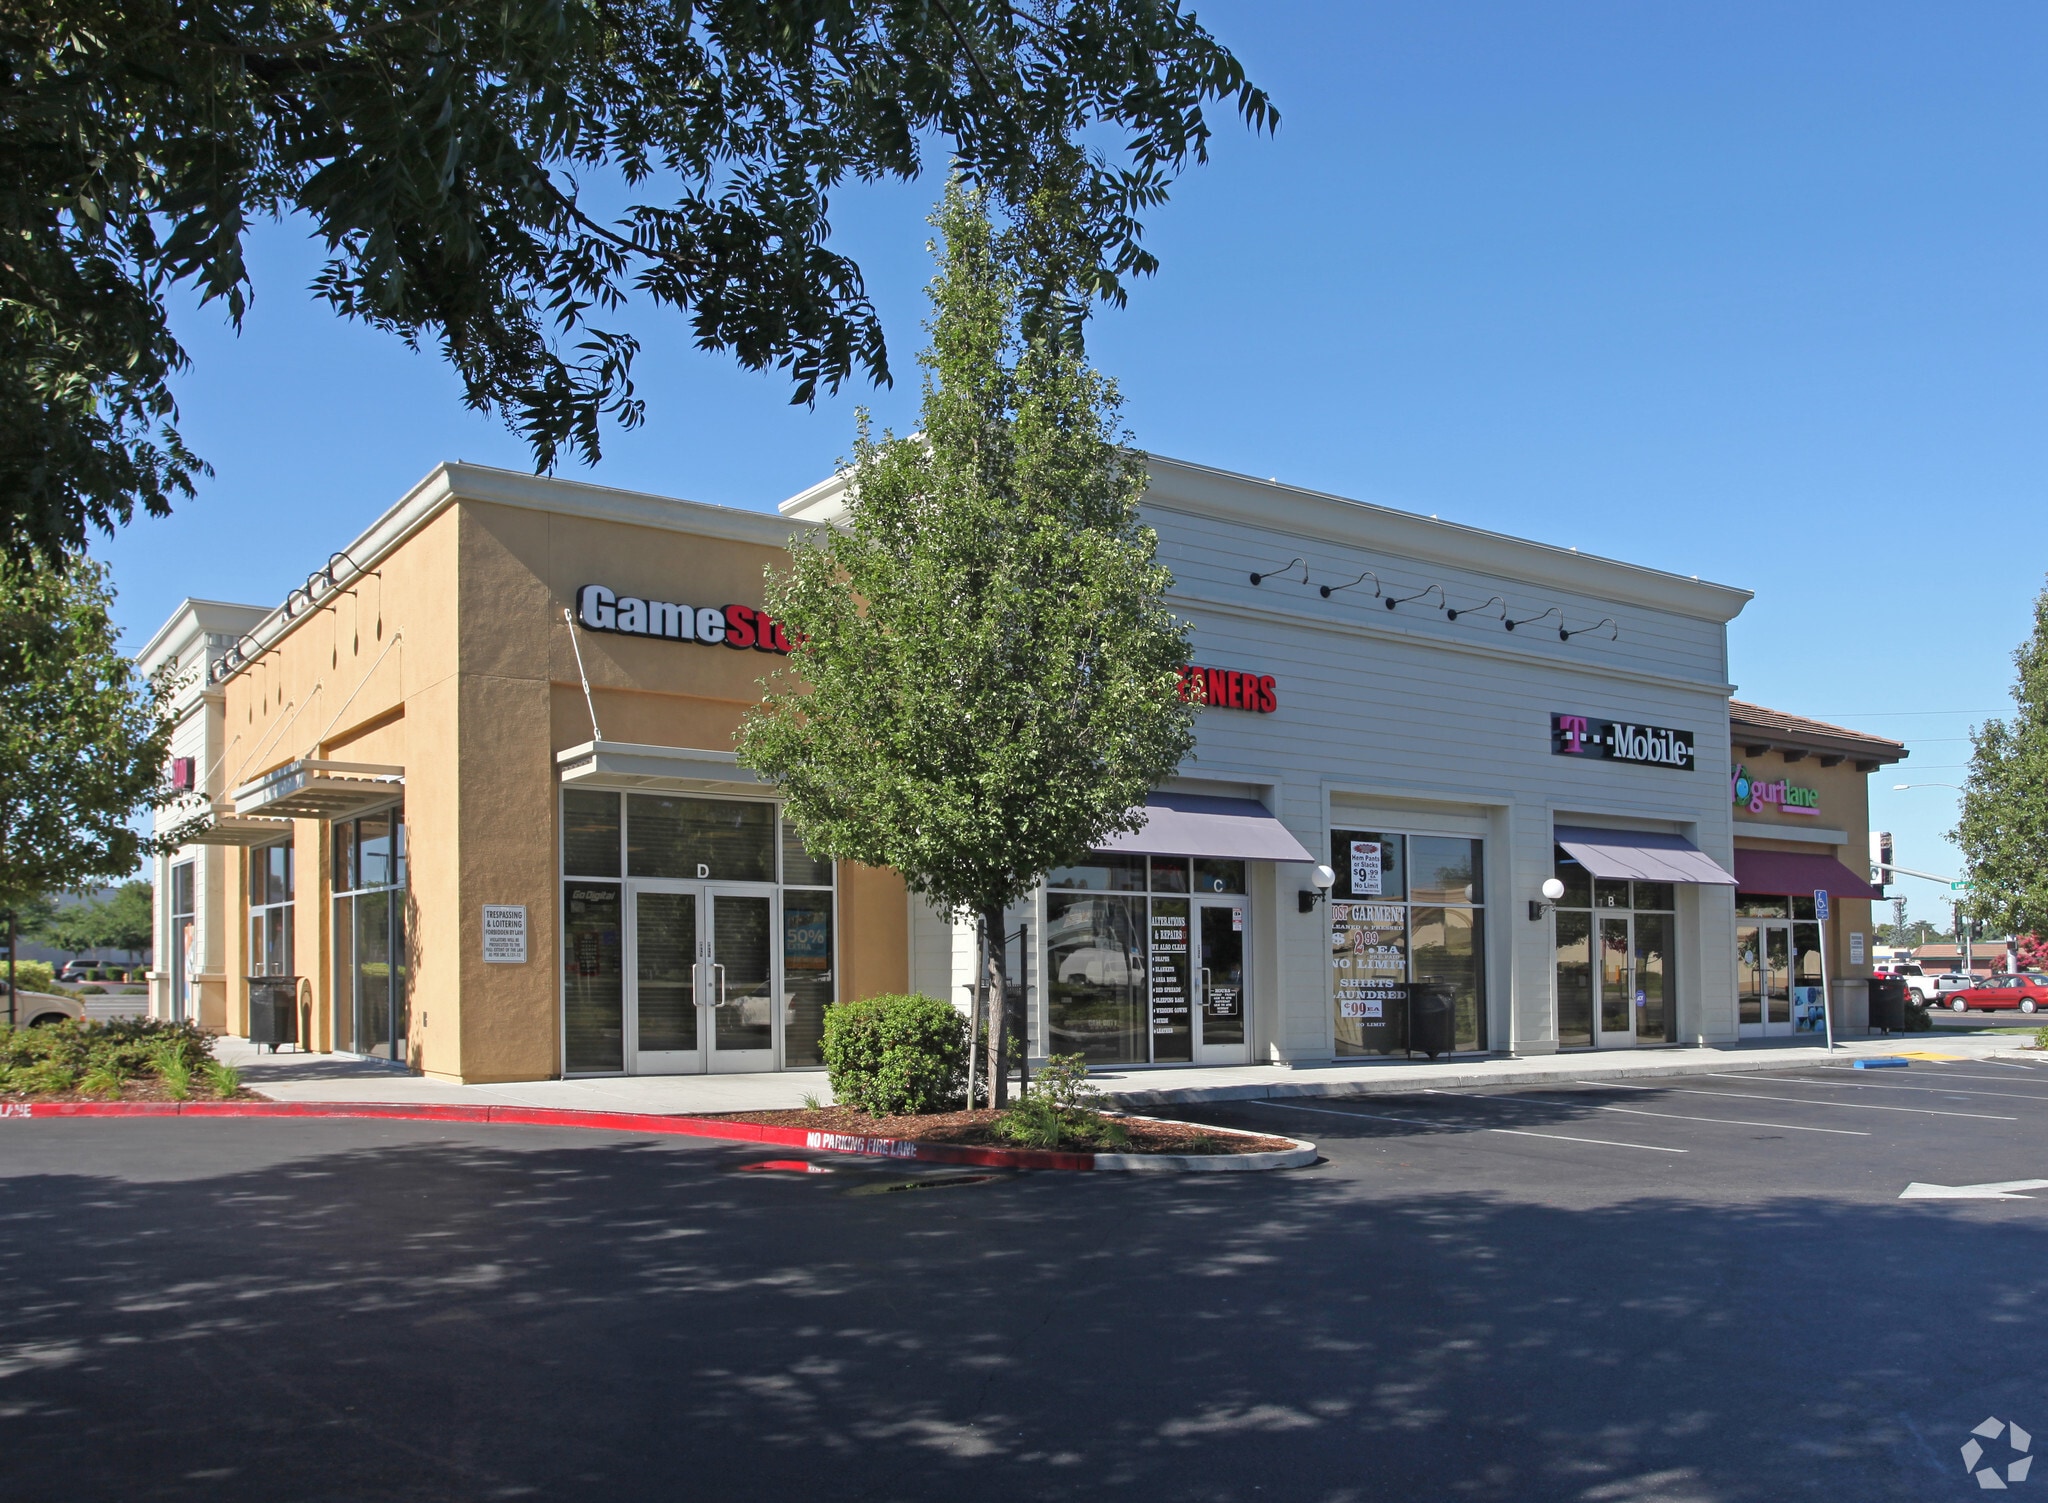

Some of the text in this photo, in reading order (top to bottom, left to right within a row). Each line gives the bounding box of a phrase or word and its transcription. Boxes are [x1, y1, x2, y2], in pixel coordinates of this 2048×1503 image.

[697, 863, 710, 878] D
[1214, 879, 1223, 892] C
[573, 890, 615, 901] Go Digital
[1608, 896, 1614, 907] B
[486, 911, 522, 919] TRESPASSING
[1352, 905, 1405, 922] GARMENT
[493, 920, 522, 928] LOITERING
[787, 929, 823, 944] 50%
[1160, 930, 1183, 940] REPAIRS
[1357, 960, 1406, 969] LIMIT
[1340, 978, 1394, 988] SHIRTS
[1333, 990, 1407, 999] AUNDRED
[807, 1132, 917, 1157] NO PARKING FIRE LANE
